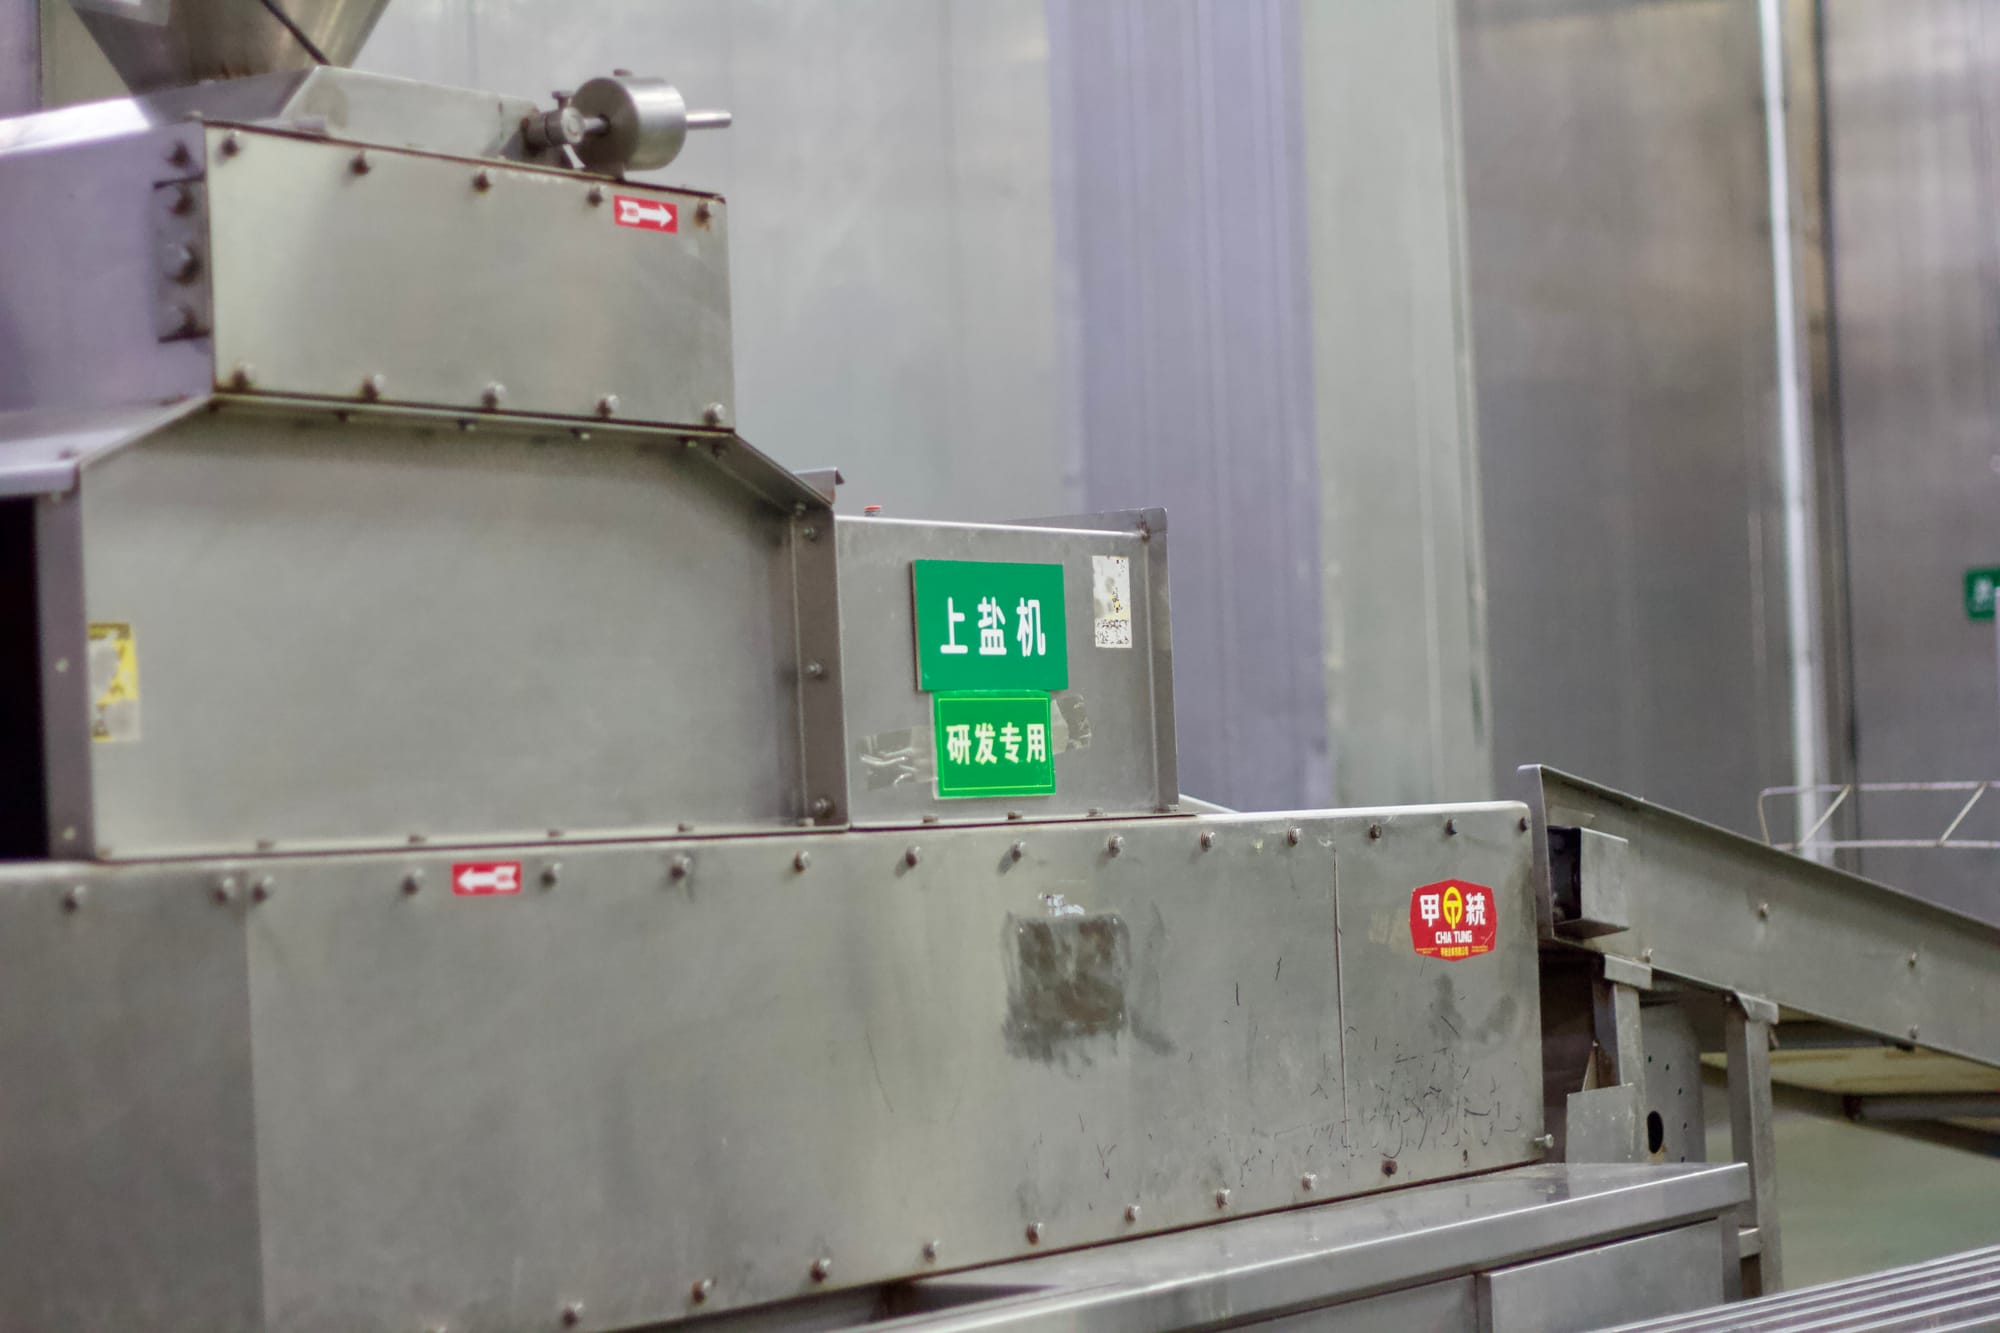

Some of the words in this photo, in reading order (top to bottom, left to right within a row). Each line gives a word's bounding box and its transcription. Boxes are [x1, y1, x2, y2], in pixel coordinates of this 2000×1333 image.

[940, 596, 1046, 657] 上盐机
[946, 721, 1046, 765] 研发专用
[1435, 931, 1452, 944] CHIA
[1453, 930, 1472, 943] TUNG
